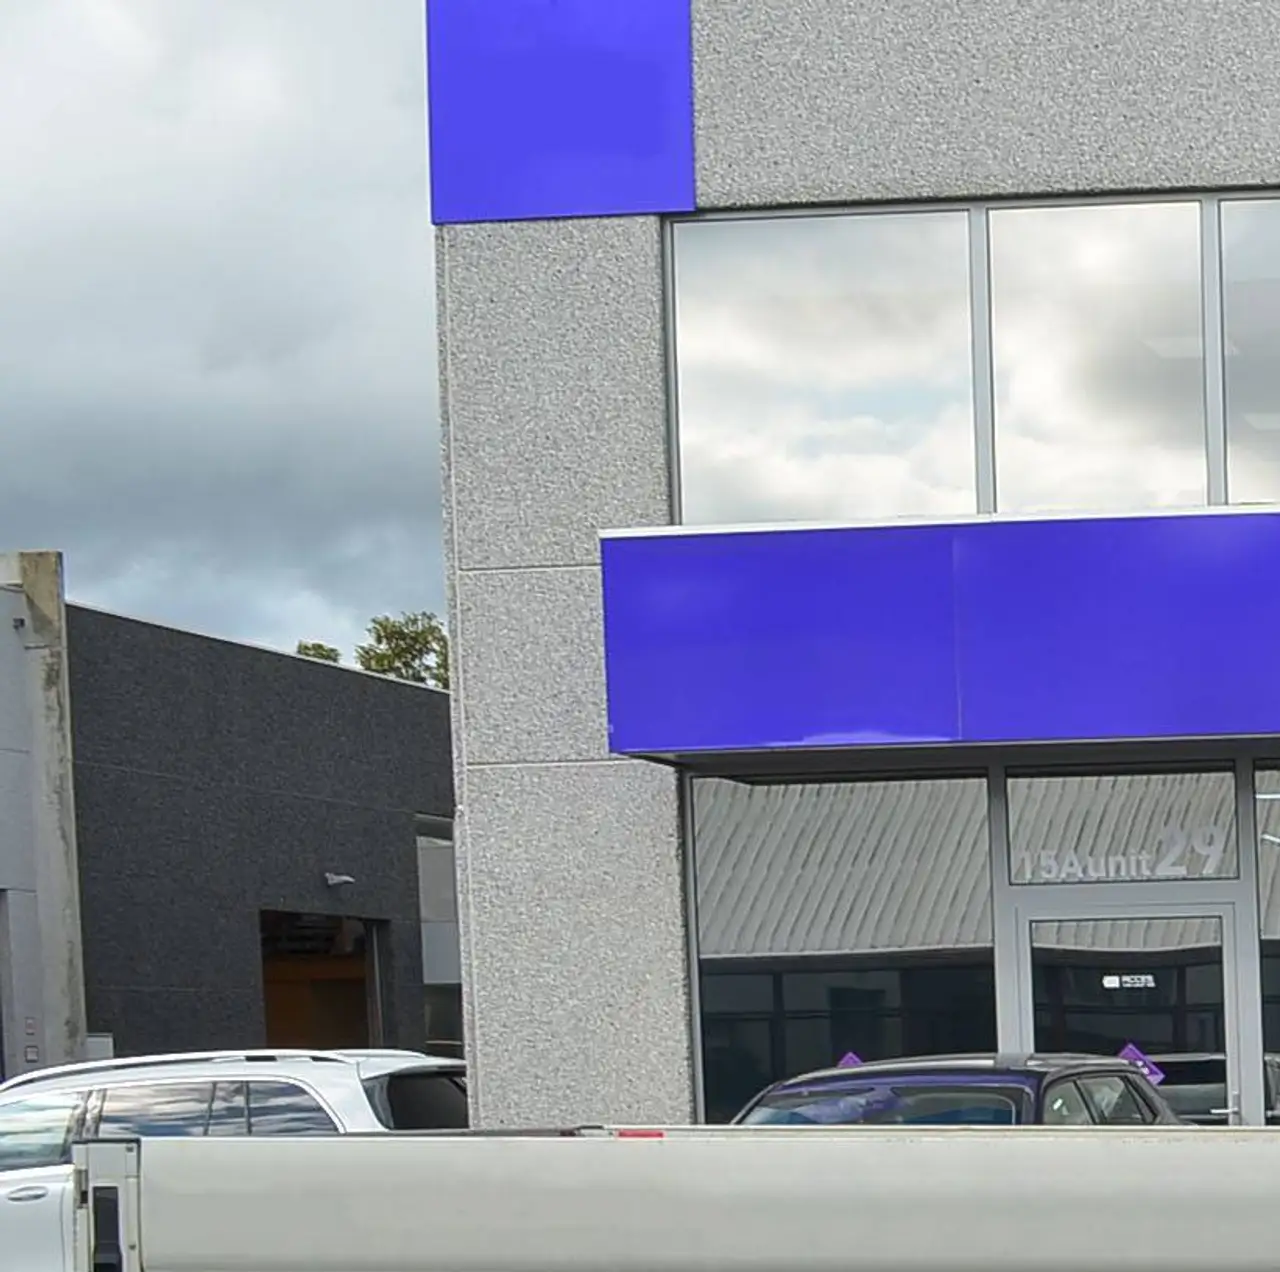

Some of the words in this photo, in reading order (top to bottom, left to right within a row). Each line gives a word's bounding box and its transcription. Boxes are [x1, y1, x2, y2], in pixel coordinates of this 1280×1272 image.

[1018, 850, 1084, 880] 15A
[1088, 848, 1152, 878] unit
[1156, 824, 1224, 876] 29
